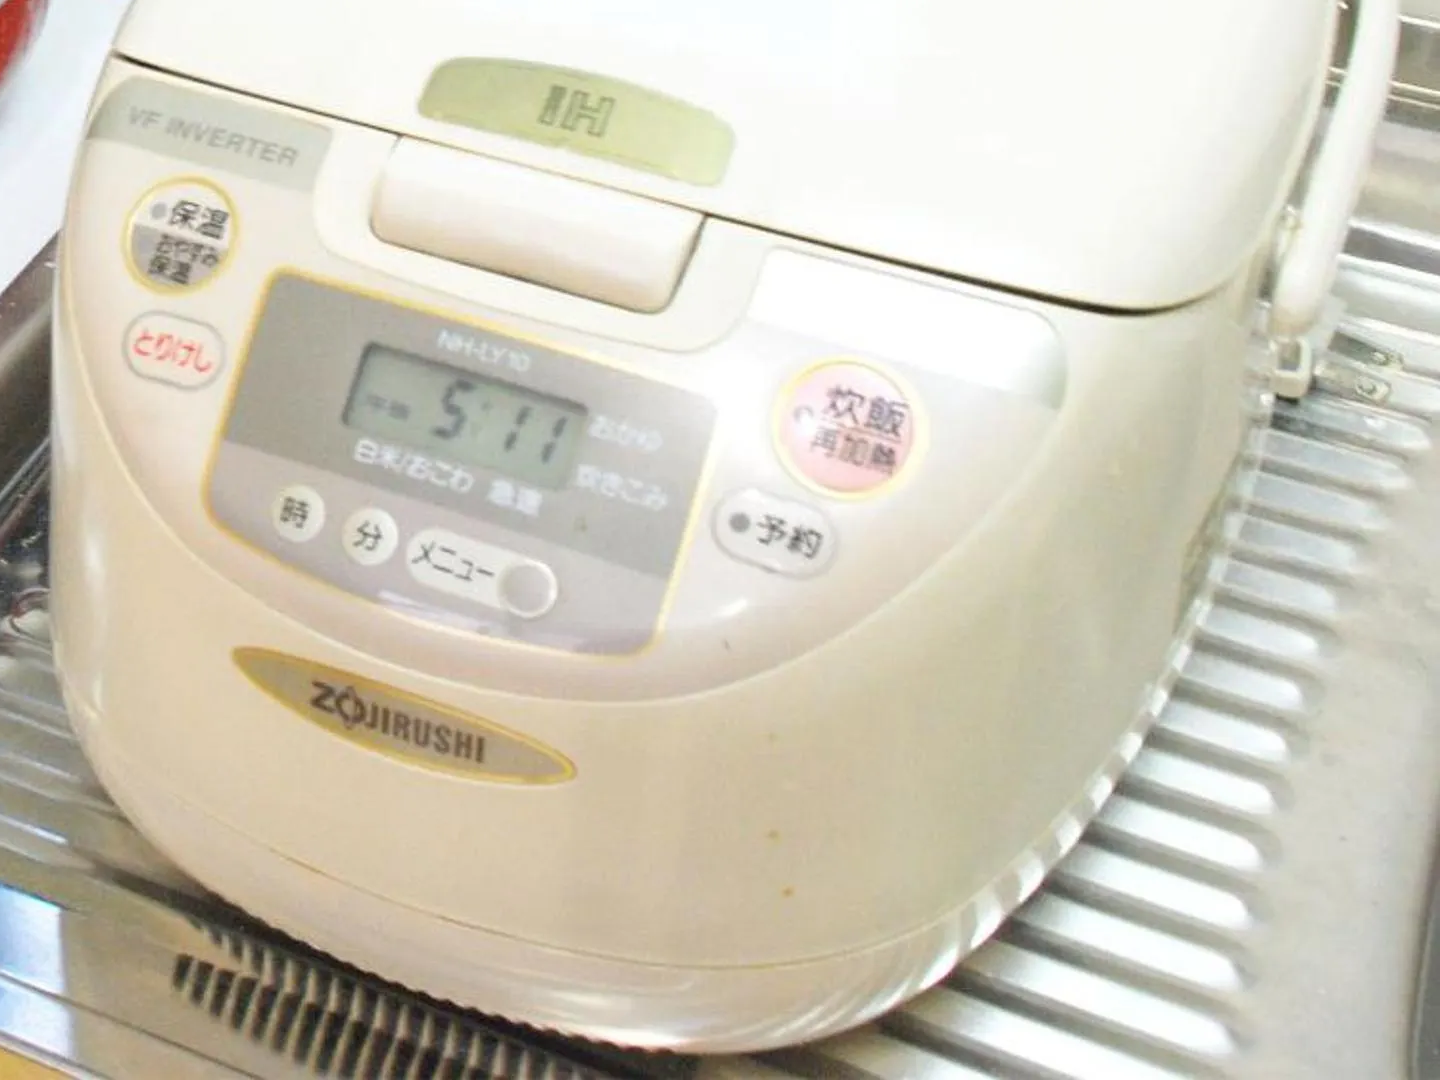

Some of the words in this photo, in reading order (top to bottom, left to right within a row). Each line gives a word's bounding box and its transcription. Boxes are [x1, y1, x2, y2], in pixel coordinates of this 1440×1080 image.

[538, 85, 616, 137] IH
[127, 105, 162, 128] VF
[167, 113, 300, 168] INVERTER
[169, 199, 229, 239] 保温
[132, 328, 213, 373] とりけし
[823, 385, 909, 436] 炊飯
[280, 496, 310, 527] 時
[352, 521, 382, 551] 分
[756, 514, 823, 558] 予約
[412, 541, 494, 582] メニュー
[310, 681, 486, 762] ZOJIRUSHI
